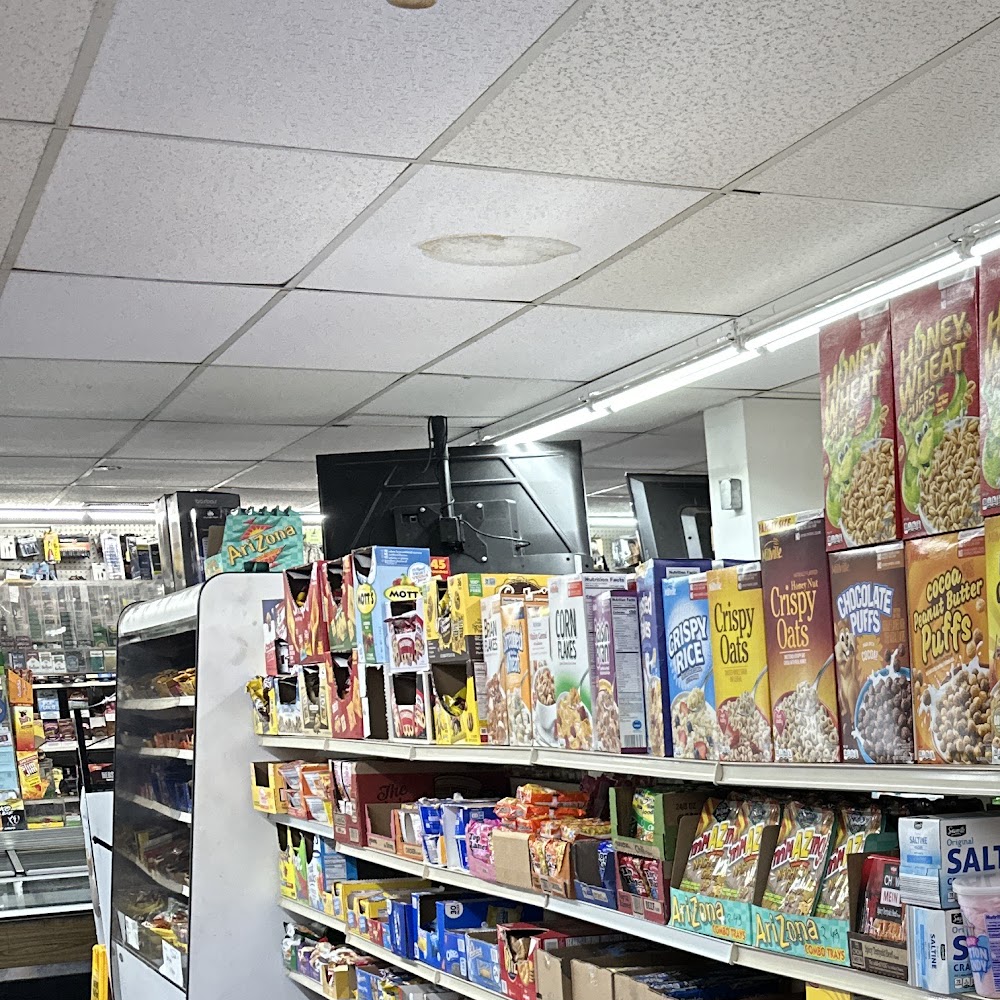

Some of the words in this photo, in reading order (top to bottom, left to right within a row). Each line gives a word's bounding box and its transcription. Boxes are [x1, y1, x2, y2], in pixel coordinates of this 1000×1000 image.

[900, 312, 968, 365] HONEY
[825, 342, 881, 398] HONEY
[899, 342, 965, 403] WHEAT
[824, 369, 880, 427] WHEAT
[226, 523, 297, 565] AriZona
[431, 559, 445, 569] 45
[791, 580, 807, 591] Honey
[808, 579, 818, 589] Nut
[926, 571, 962, 601] cocoa
[770, 585, 816, 622] Crispy
[837, 584, 893, 619] CHOCOLATE
[913, 602, 946, 633] Peanut
[947, 578, 984, 617] Butter
[484, 620, 497, 640] BRAN
[555, 608, 577, 638] CORN
[714, 602, 755, 638] Crispy
[776, 619, 809, 649] Oats
[851, 610, 881, 635] PUFFS
[484, 639, 498, 655] FLAKES
[558, 640, 576, 660] FLAKES
[668, 615, 708, 659] CRISPY
[720, 637, 749, 664] Oats
[921, 610, 973, 664] Puffs
[674, 640, 704, 672] RICE
[947, 837, 974, 847] Original
[671, 895, 724, 927] AriZona
[884, 891, 898, 903] MEIN
[712, 924, 729, 936] COMBO
[730, 928, 746, 941] TRAYS
[755, 913, 820, 950] AriZona
[804, 944, 827, 956] COMBO
[828, 946, 845, 960] TRAYS
